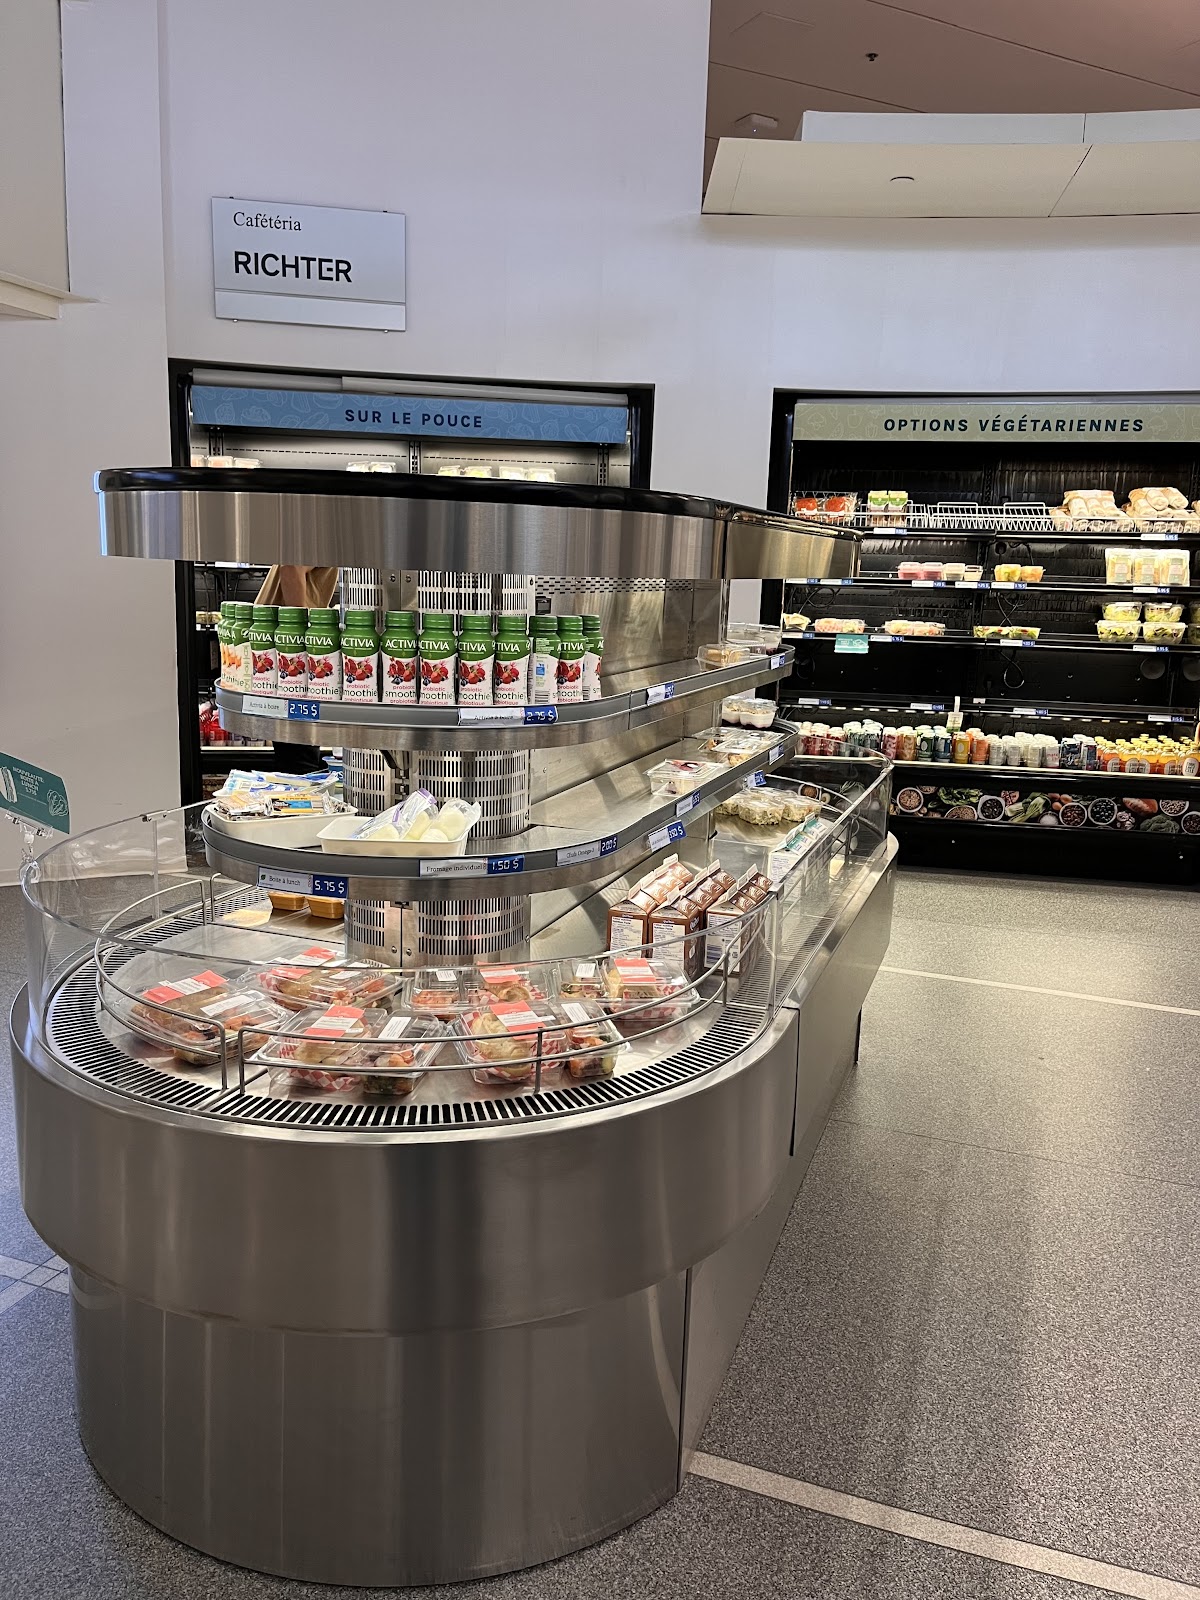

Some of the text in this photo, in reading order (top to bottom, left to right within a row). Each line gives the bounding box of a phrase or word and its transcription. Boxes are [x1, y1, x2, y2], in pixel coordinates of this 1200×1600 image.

[233, 211, 302, 231] Cafétéria
[234, 250, 352, 283] RICHTER
[345, 408, 483, 428] SUR LE POUCE
[883, 414, 1145, 433] OPTIONS VÉGÉTARIENNES
[305, 635, 333, 646] CTIVIA
[385, 639, 418, 649] ACTIVI
[420, 640, 450, 651] CTIVIA
[459, 641, 487, 652] CTIVIA
[496, 642, 520, 653] TIVIA
[344, 688, 378, 697] moothie
[385, 690, 417, 698] smooth
[420, 691, 453, 700] moothie
[289, 703, 309, 715] 2.75
[310, 703, 318, 718] $
[526, 711, 546, 721] 2.75
[547, 710, 555, 721] $
[677, 825, 684, 836] $
[453, 863, 483, 871] individuel
[492, 860, 510, 871] 1.50
[512, 857, 519, 870] $
[314, 880, 336, 892] 5.75
[337, 880, 345, 895] $
